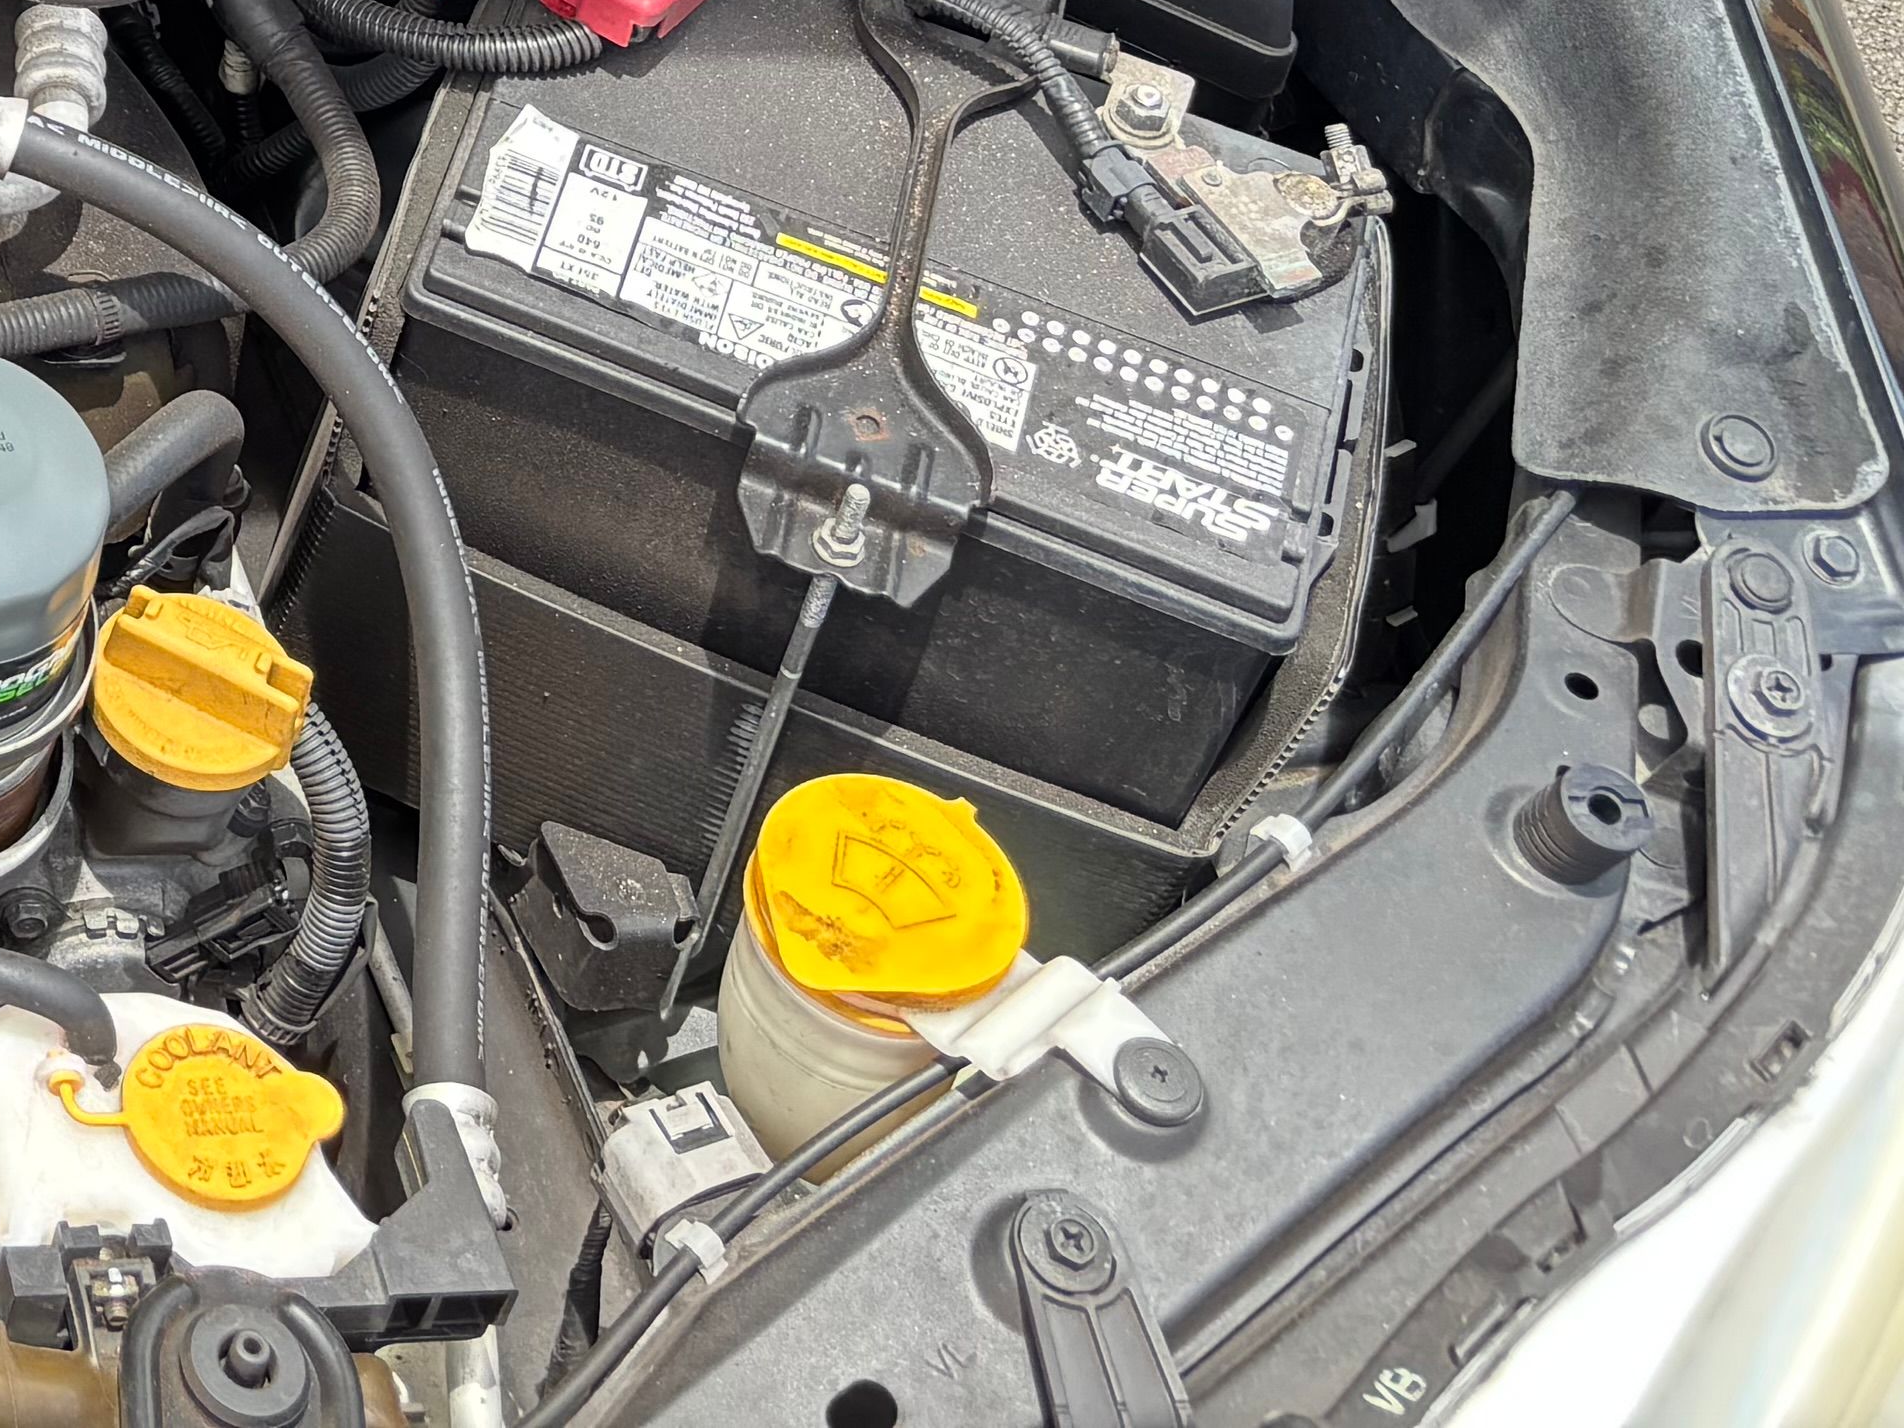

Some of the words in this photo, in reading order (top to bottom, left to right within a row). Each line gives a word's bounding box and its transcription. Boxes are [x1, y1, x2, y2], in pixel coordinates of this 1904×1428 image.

[589, 185, 618, 201] 12V
[693, 295, 719, 311] WITH
[786, 332, 812, 348] ACID
[697, 330, 774, 372] OISON
[1093, 465, 1250, 542] SUPER
[135, 1027, 283, 1089] COOLANT
[186, 1076, 228, 1096] SEE
[183, 1116, 264, 1137] MANUAL
[1363, 1366, 1427, 1416] VB
